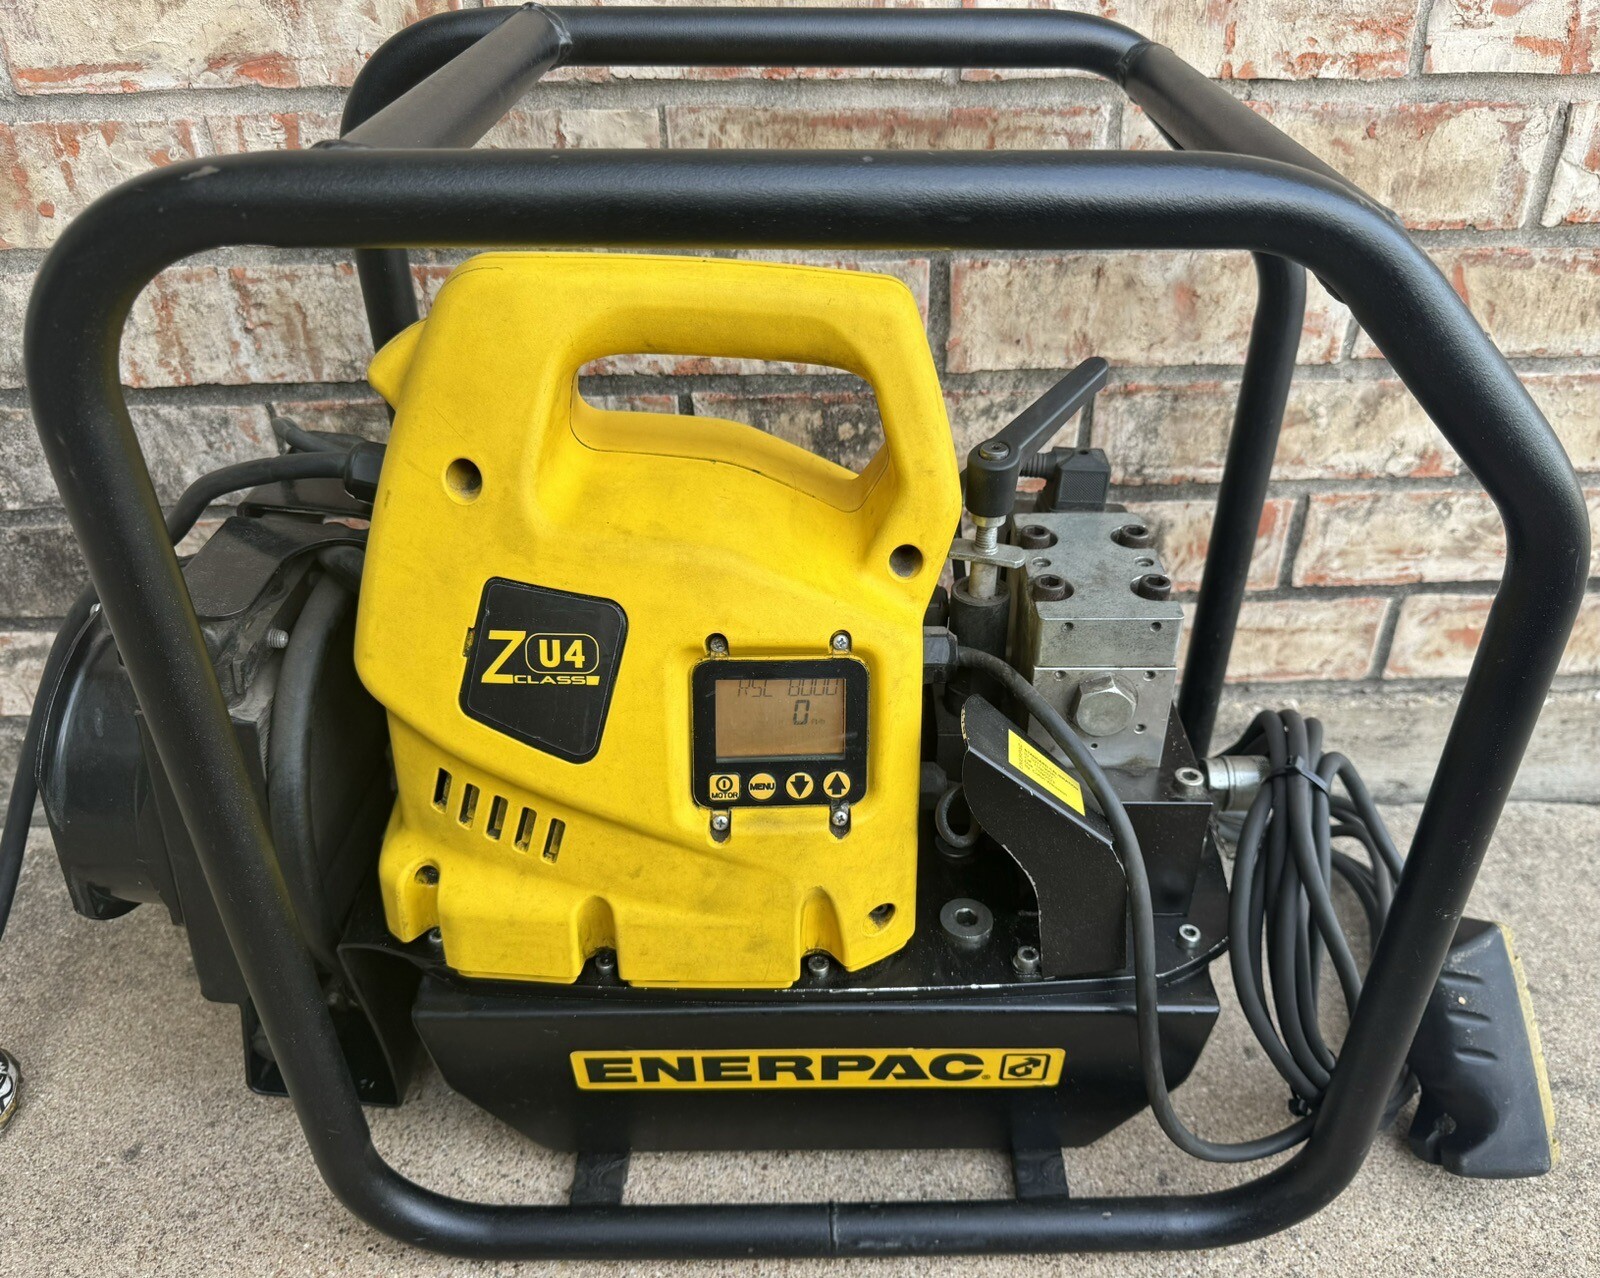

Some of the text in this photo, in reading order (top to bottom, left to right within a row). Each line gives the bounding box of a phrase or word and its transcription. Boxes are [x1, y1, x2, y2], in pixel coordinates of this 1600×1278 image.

[481, 630, 585, 684] Z U4
[514, 674, 587, 685] CLASS
[793, 699, 811, 726] 0
[711, 791, 739, 799] MOTOR
[749, 782, 776, 791] MENU
[583, 1052, 985, 1083] ENERPAC
